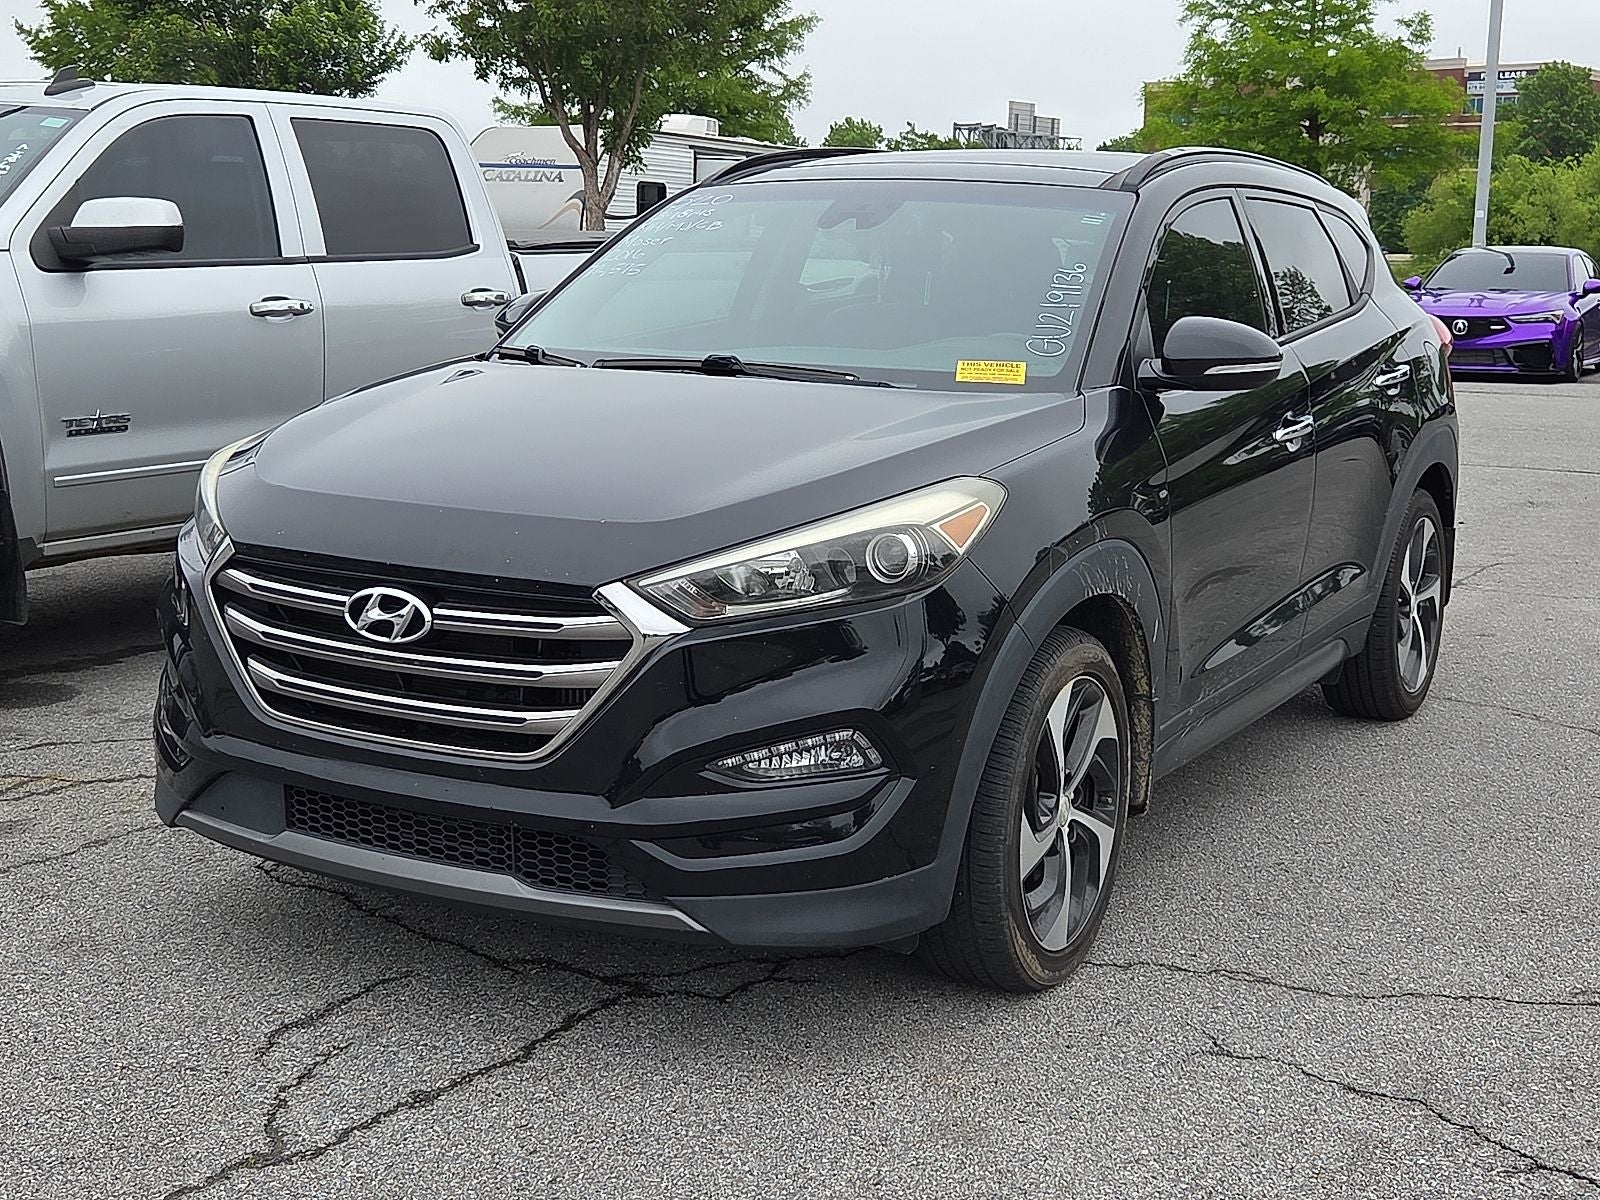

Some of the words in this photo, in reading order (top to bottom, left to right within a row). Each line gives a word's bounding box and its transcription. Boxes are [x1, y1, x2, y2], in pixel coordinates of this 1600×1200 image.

[482, 169, 564, 183] CATALINA
[1025, 263, 1087, 357] GU219136
[983, 361, 1021, 369] VEHICLE
